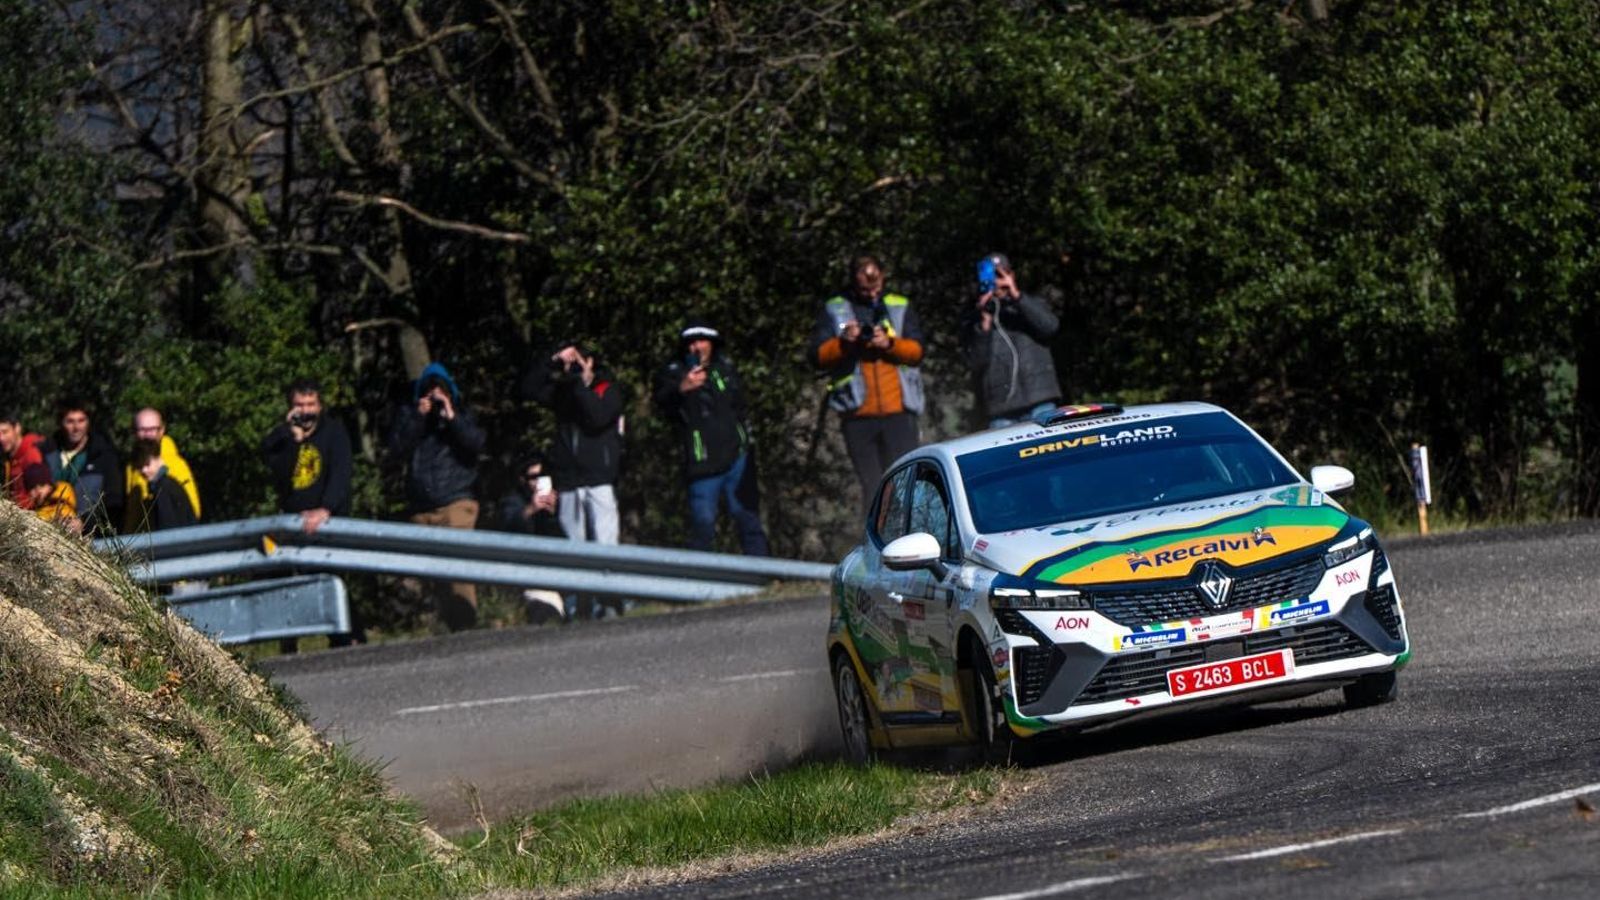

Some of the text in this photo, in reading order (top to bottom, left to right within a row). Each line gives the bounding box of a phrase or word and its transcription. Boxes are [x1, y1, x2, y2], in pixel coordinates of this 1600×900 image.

[1019, 426, 1173, 458] DRIVELAND
[1101, 432, 1177, 447] MOTORSPORT
[1154, 538, 1249, 566] Recalvi
[1335, 569, 1361, 587] AON
[1282, 605, 1323, 619] MICHELIN
[1055, 617, 1089, 630] AON
[1135, 633, 1179, 644] MICHELIN
[1175, 659, 1275, 691] S 2463 BCL
